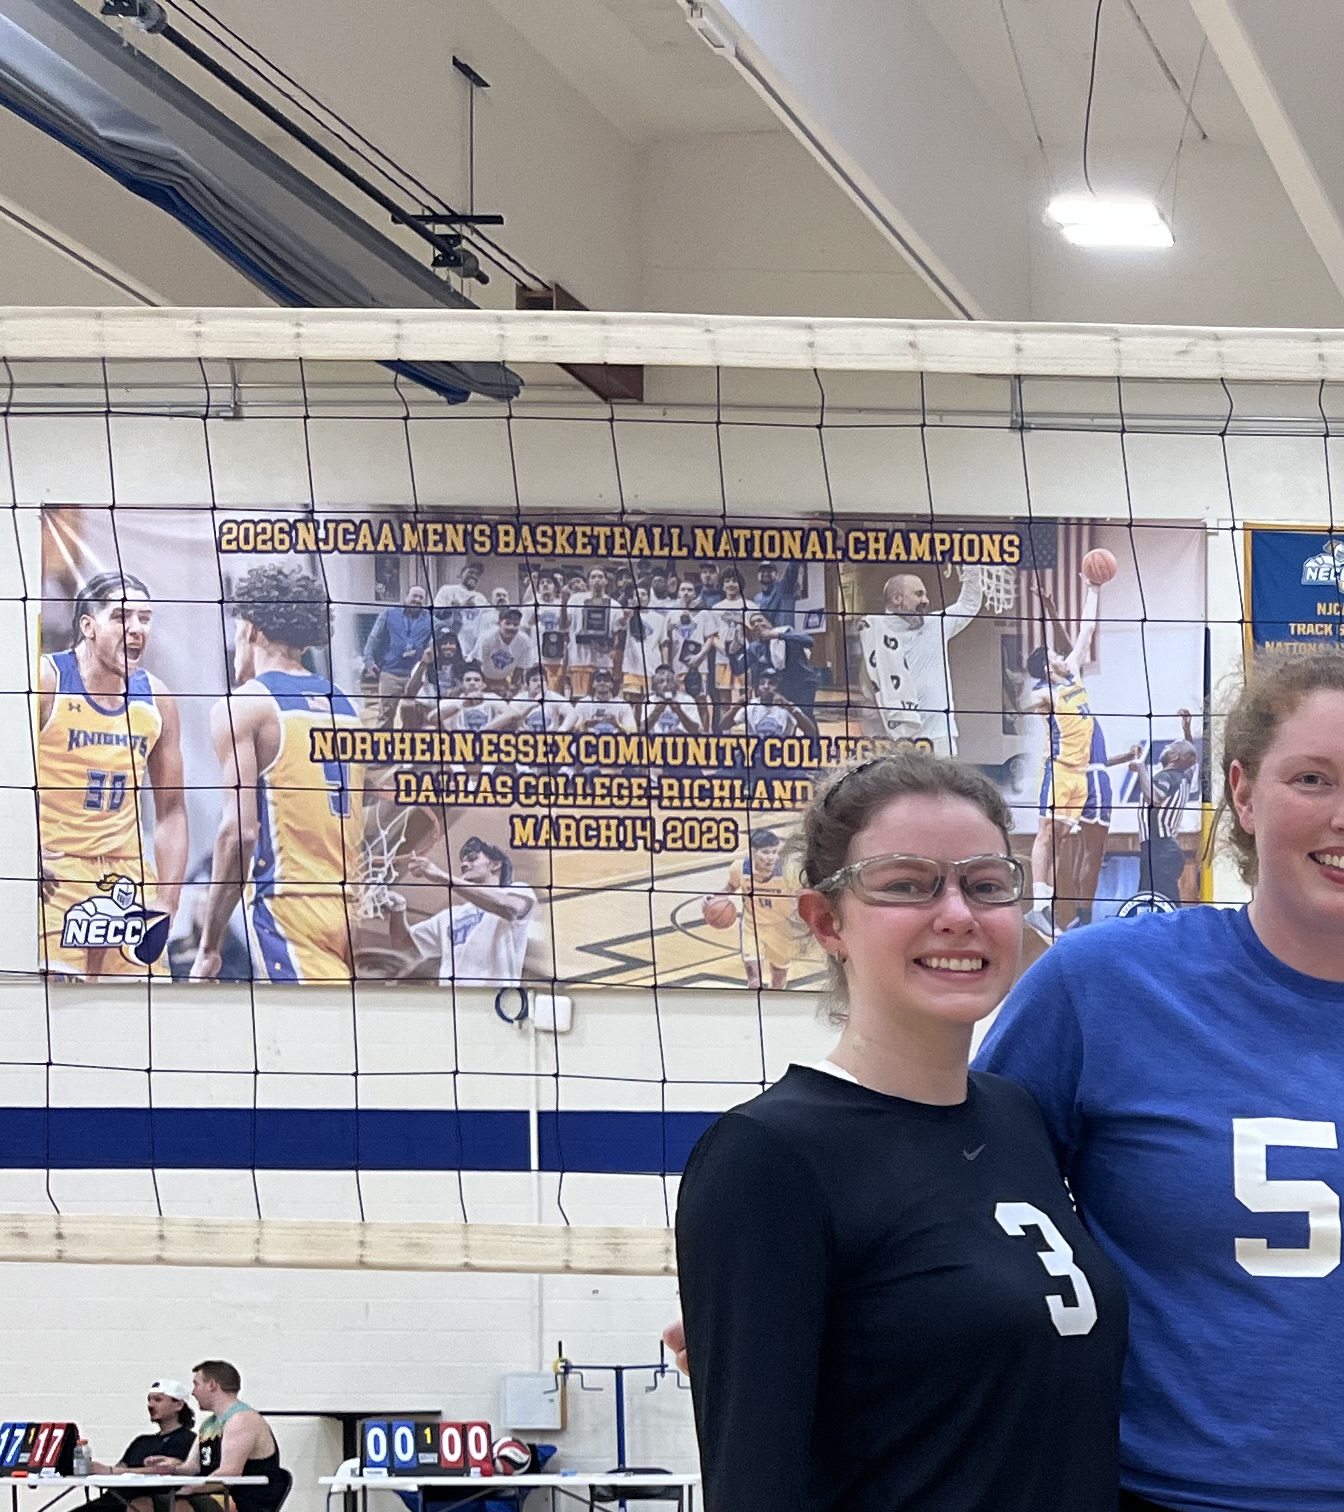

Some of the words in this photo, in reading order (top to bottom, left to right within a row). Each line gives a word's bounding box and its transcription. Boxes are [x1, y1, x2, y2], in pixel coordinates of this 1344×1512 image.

[219, 519, 297, 554] 2026
[297, 519, 396, 555] NJCAA
[401, 521, 492, 556] MEN'S
[497, 522, 690, 560] BASKETBALL
[694, 526, 842, 563] NATIONAL
[846, 529, 1022, 565] CHAMPIONS
[1288, 623, 1333, 636] TRACK
[1265, 641, 1332, 656] NATIONA
[312, 729, 475, 764] NORTHERN
[481, 731, 574, 765] ESSEX
[578, 733, 760, 768] COMMUNITY
[397, 772, 513, 806] DALLAS
[511, 816, 620, 850] MARCH
[624, 817, 661, 853] 14,
[664, 817, 739, 851] 2026
[65, 918, 144, 946] NECC
[994, 1201, 1098, 1337] 3
[0, 1428, 26, 1463] 17
[34, 1428, 65, 1463] 17
[366, 1426, 414, 1462] 00
[424, 1427, 432, 1444] 1
[442, 1425, 488, 1462] 00
